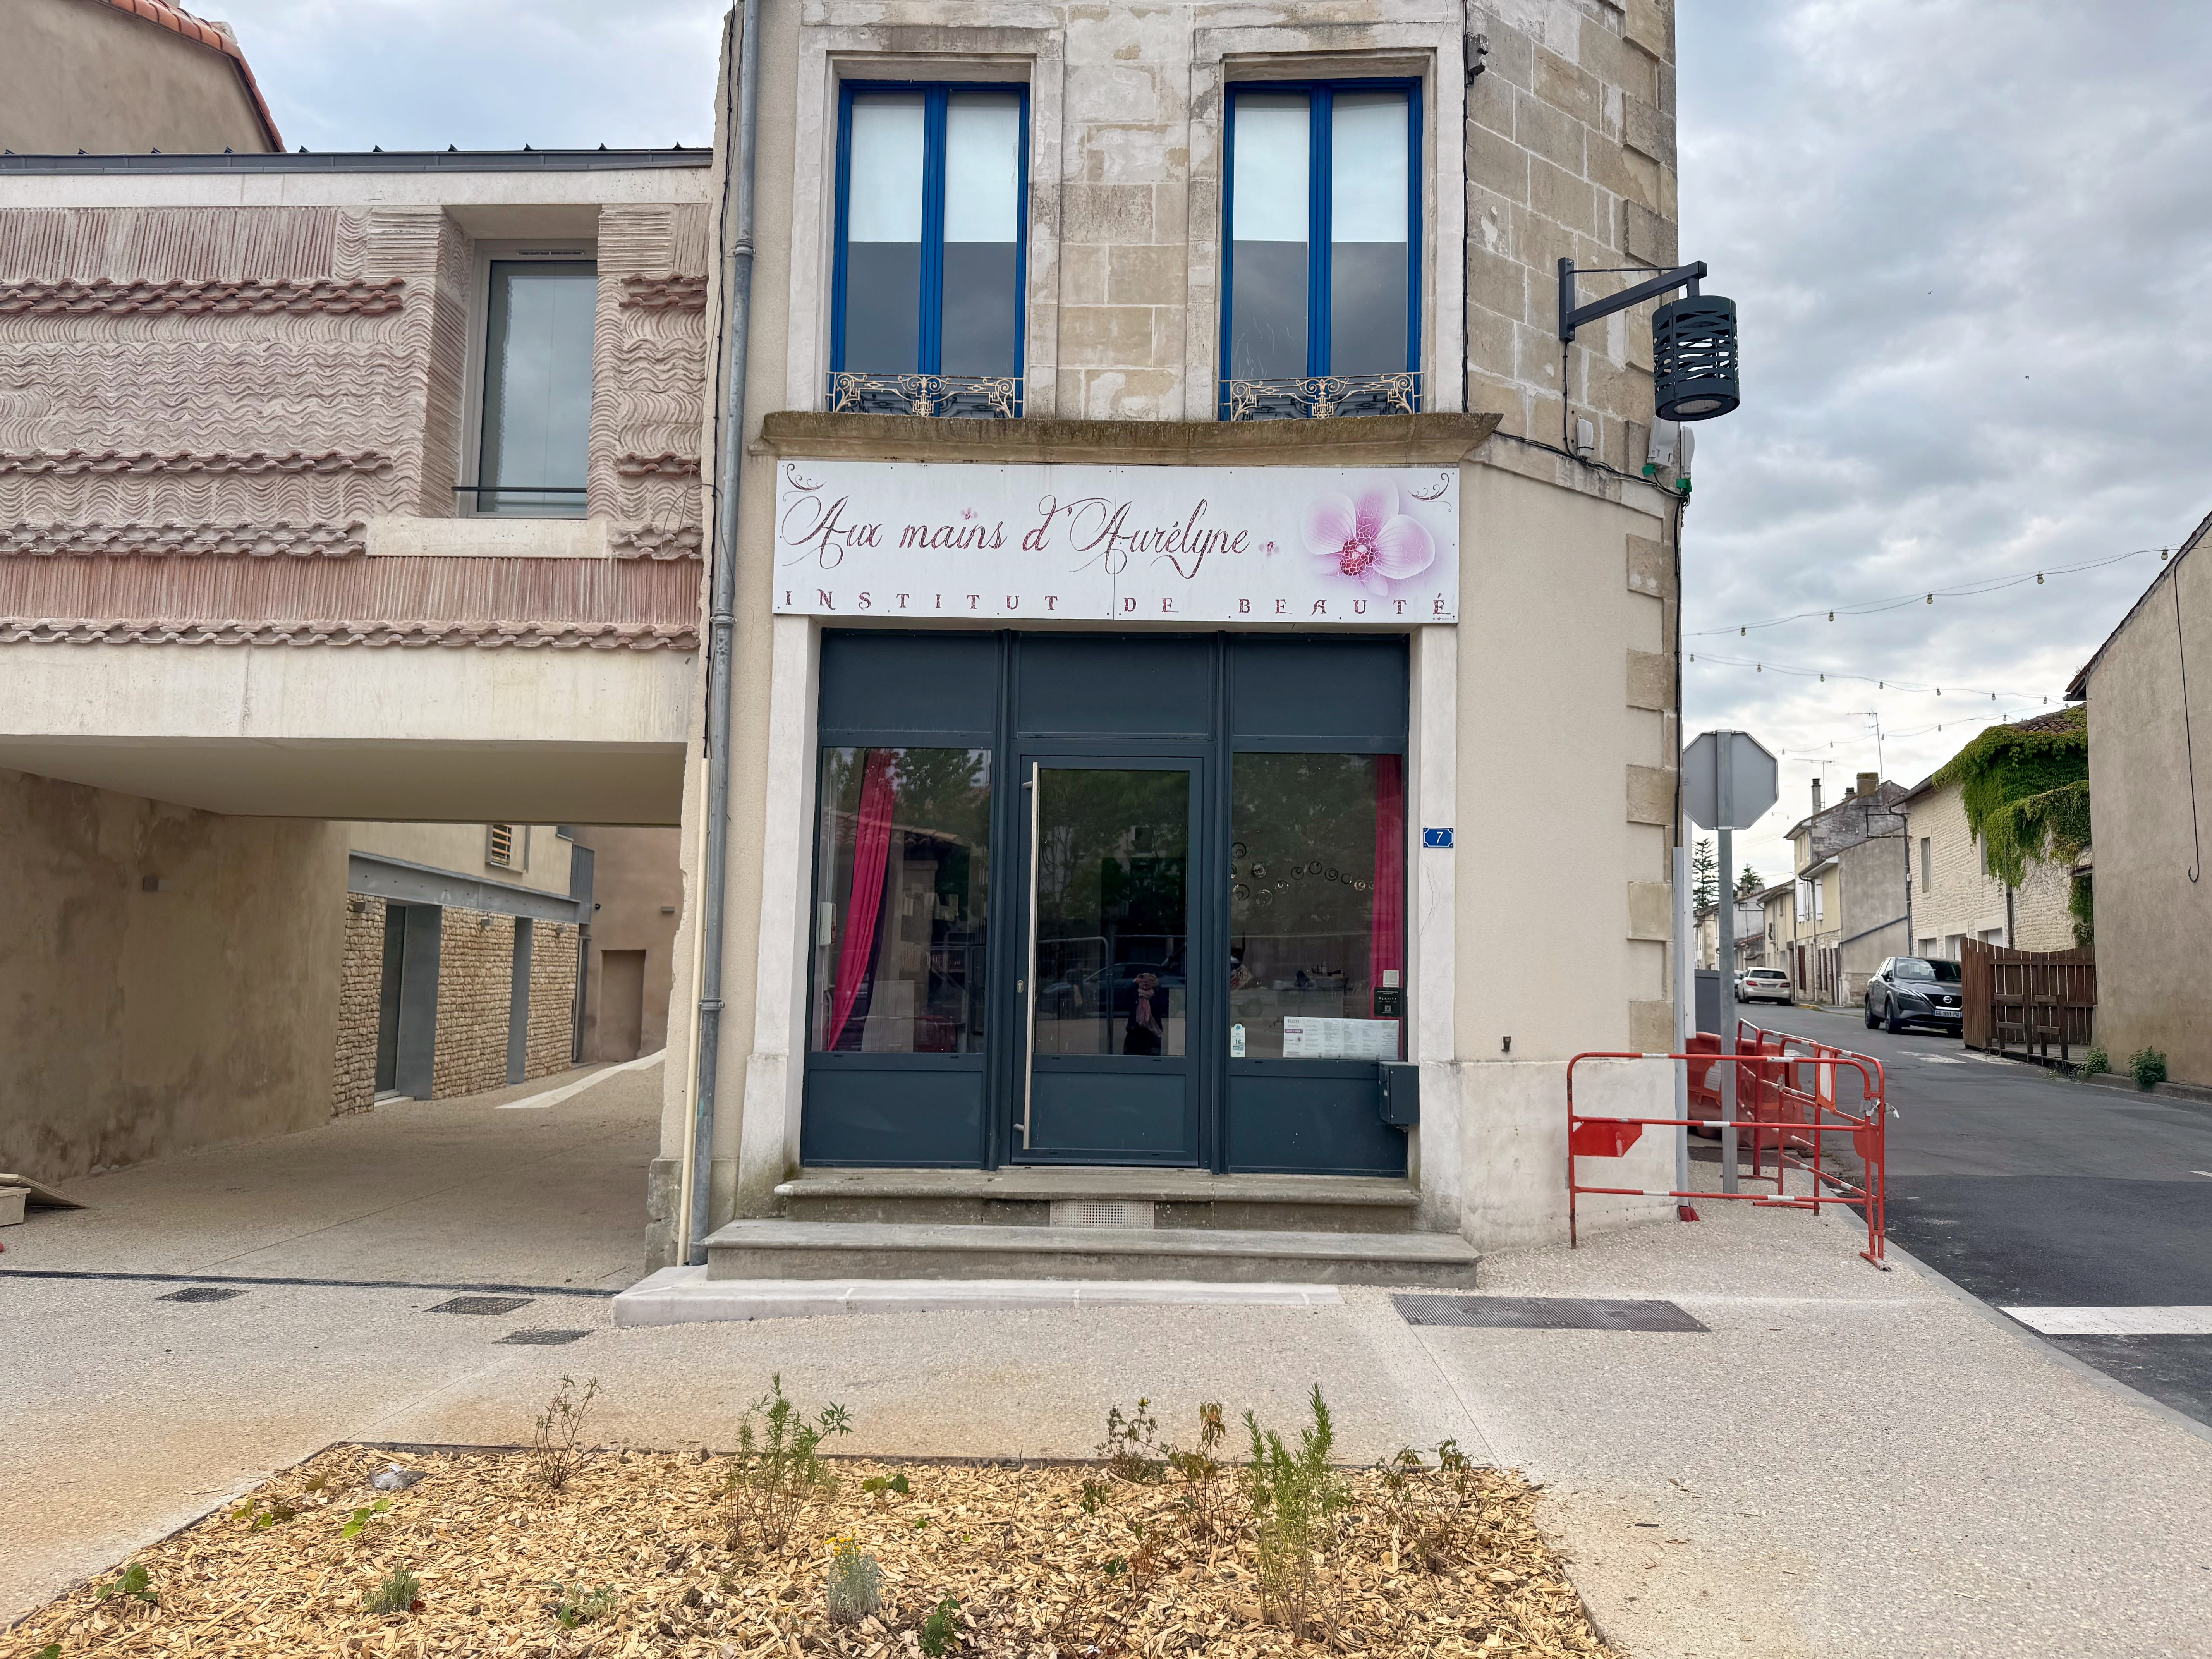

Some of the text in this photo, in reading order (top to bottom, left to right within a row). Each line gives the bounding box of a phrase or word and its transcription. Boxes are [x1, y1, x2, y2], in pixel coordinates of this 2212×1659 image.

[782, 495, 1250, 579] Aux mains d'Aurélyne
[785, 589, 1451, 616] INSTITUT DE BEAUTÉ
[1436, 831, 1443, 844] 7
